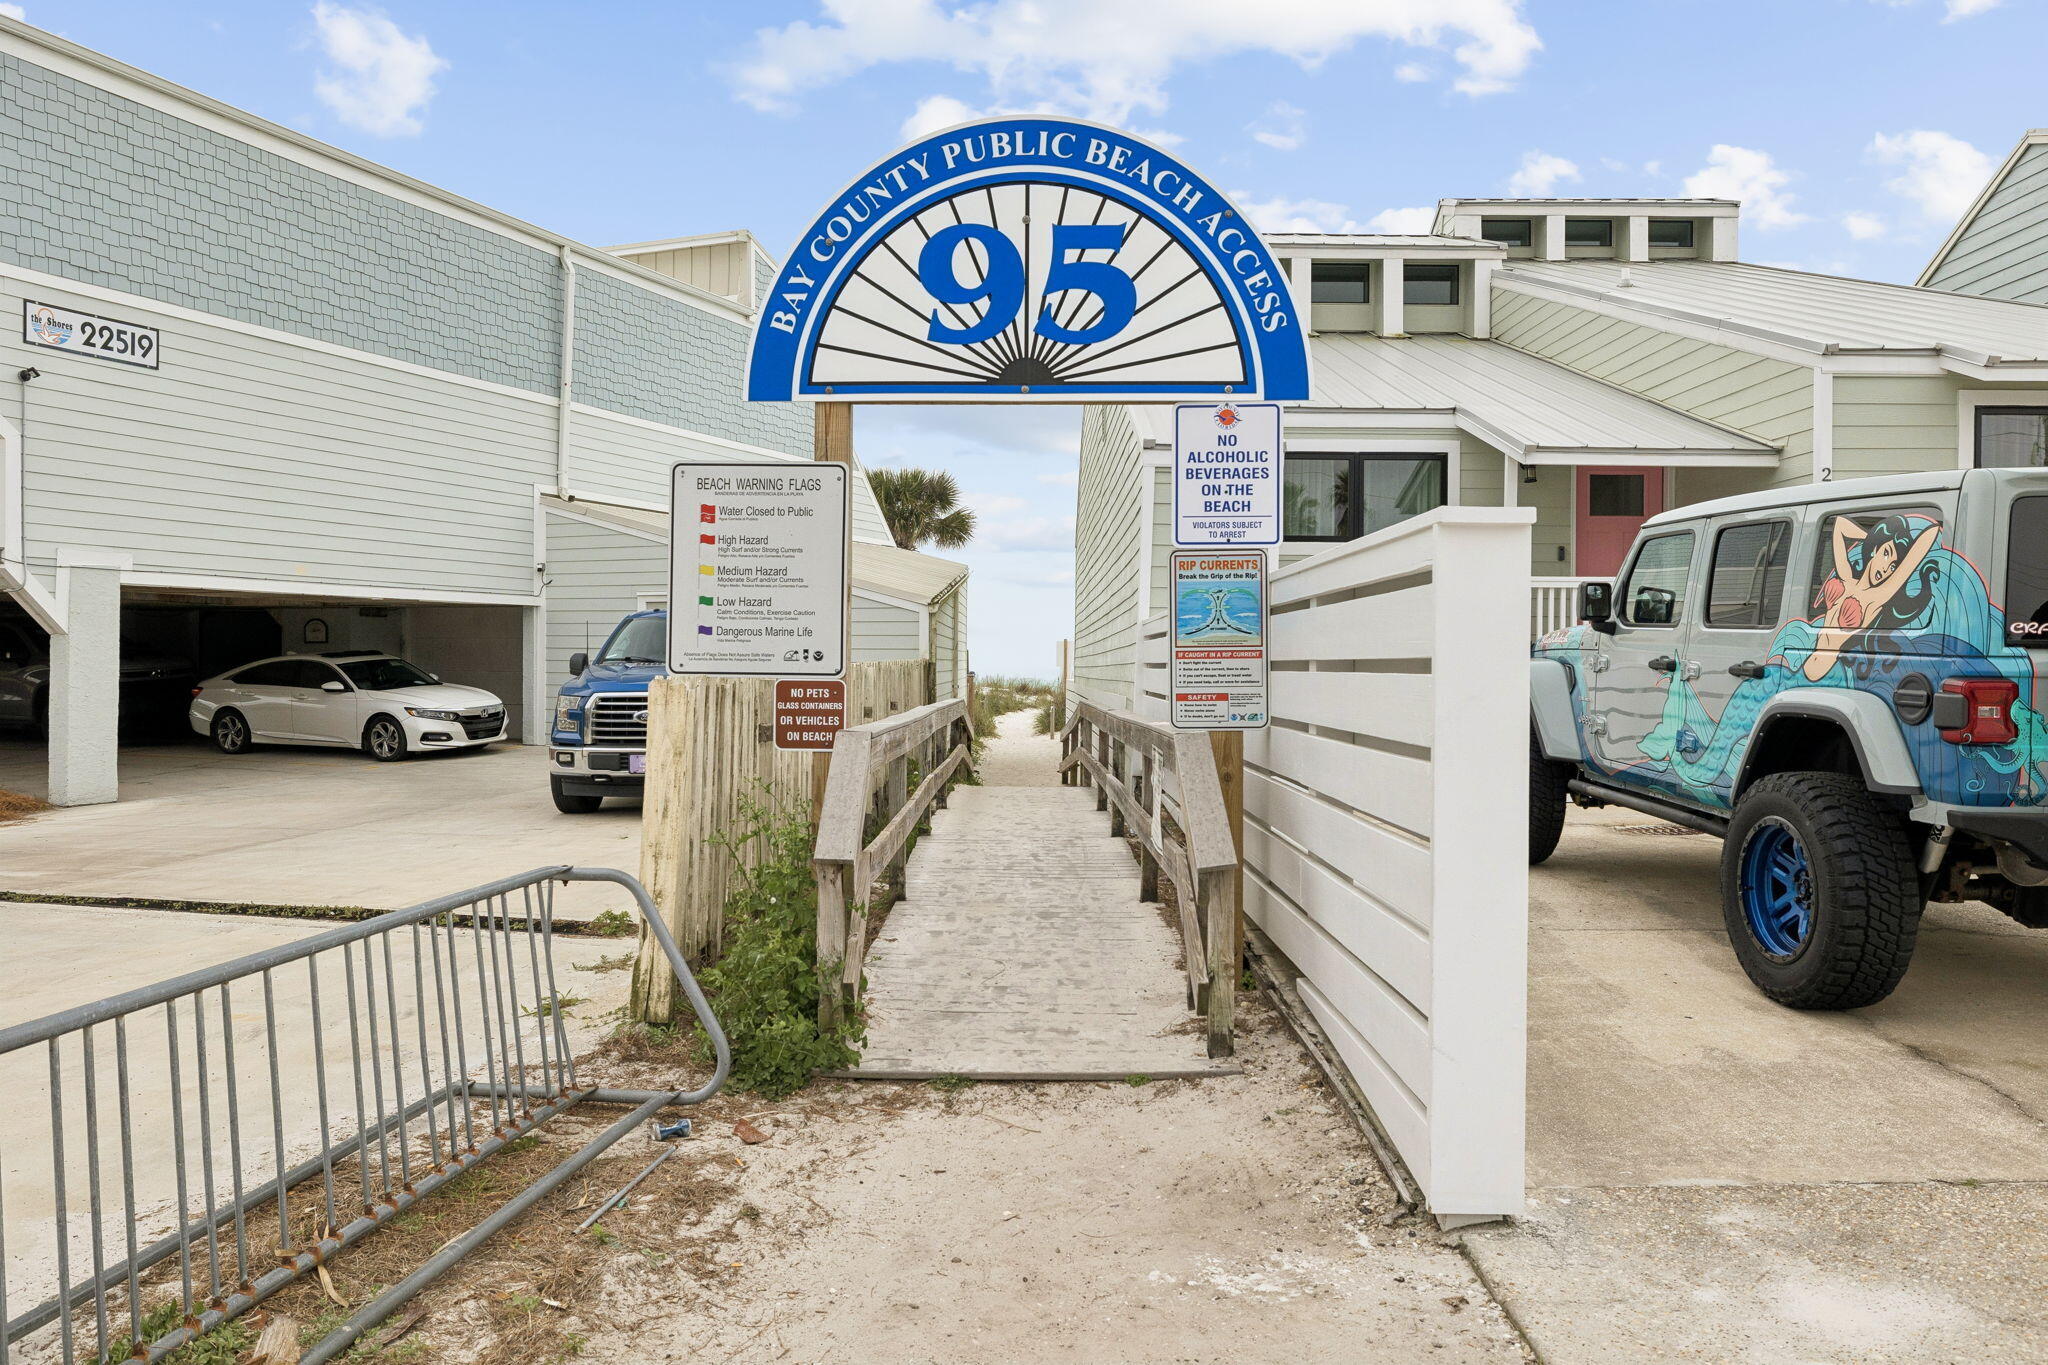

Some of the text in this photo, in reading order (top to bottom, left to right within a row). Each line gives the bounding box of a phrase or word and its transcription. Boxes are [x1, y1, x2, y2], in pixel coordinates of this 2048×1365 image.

[770, 131, 1288, 335] BAY COUNTY PUBLIC BEACH ACCESS
[918, 221, 1137, 345] 95
[31, 314, 73, 331] the Shores
[80, 321, 154, 358] 22519
[1218, 435, 1238, 446] NO
[1187, 450, 1268, 463] ALCOHOLIC
[1186, 467, 1269, 480] BEVERAGES
[1822, 468, 1831, 482] 2
[697, 478, 821, 491] BEACH WARNING FLAGS
[1201, 484, 1254, 496] ON THE
[719, 506, 813, 517] Water Closed to Public
[1204, 501, 1251, 512] BEACH
[718, 536, 768, 547] High Hazard
[1179, 560, 1258, 570] RIP CURRENTS
[718, 566, 787, 576] Medium Hazard
[717, 597, 772, 606] Low Hazard
[717, 626, 813, 638] Dangerous Marine Life
[791, 688, 829, 698] NO PETS
[780, 716, 839, 725] OR VEHICLES
[787, 732, 832, 740] ON BEACH
